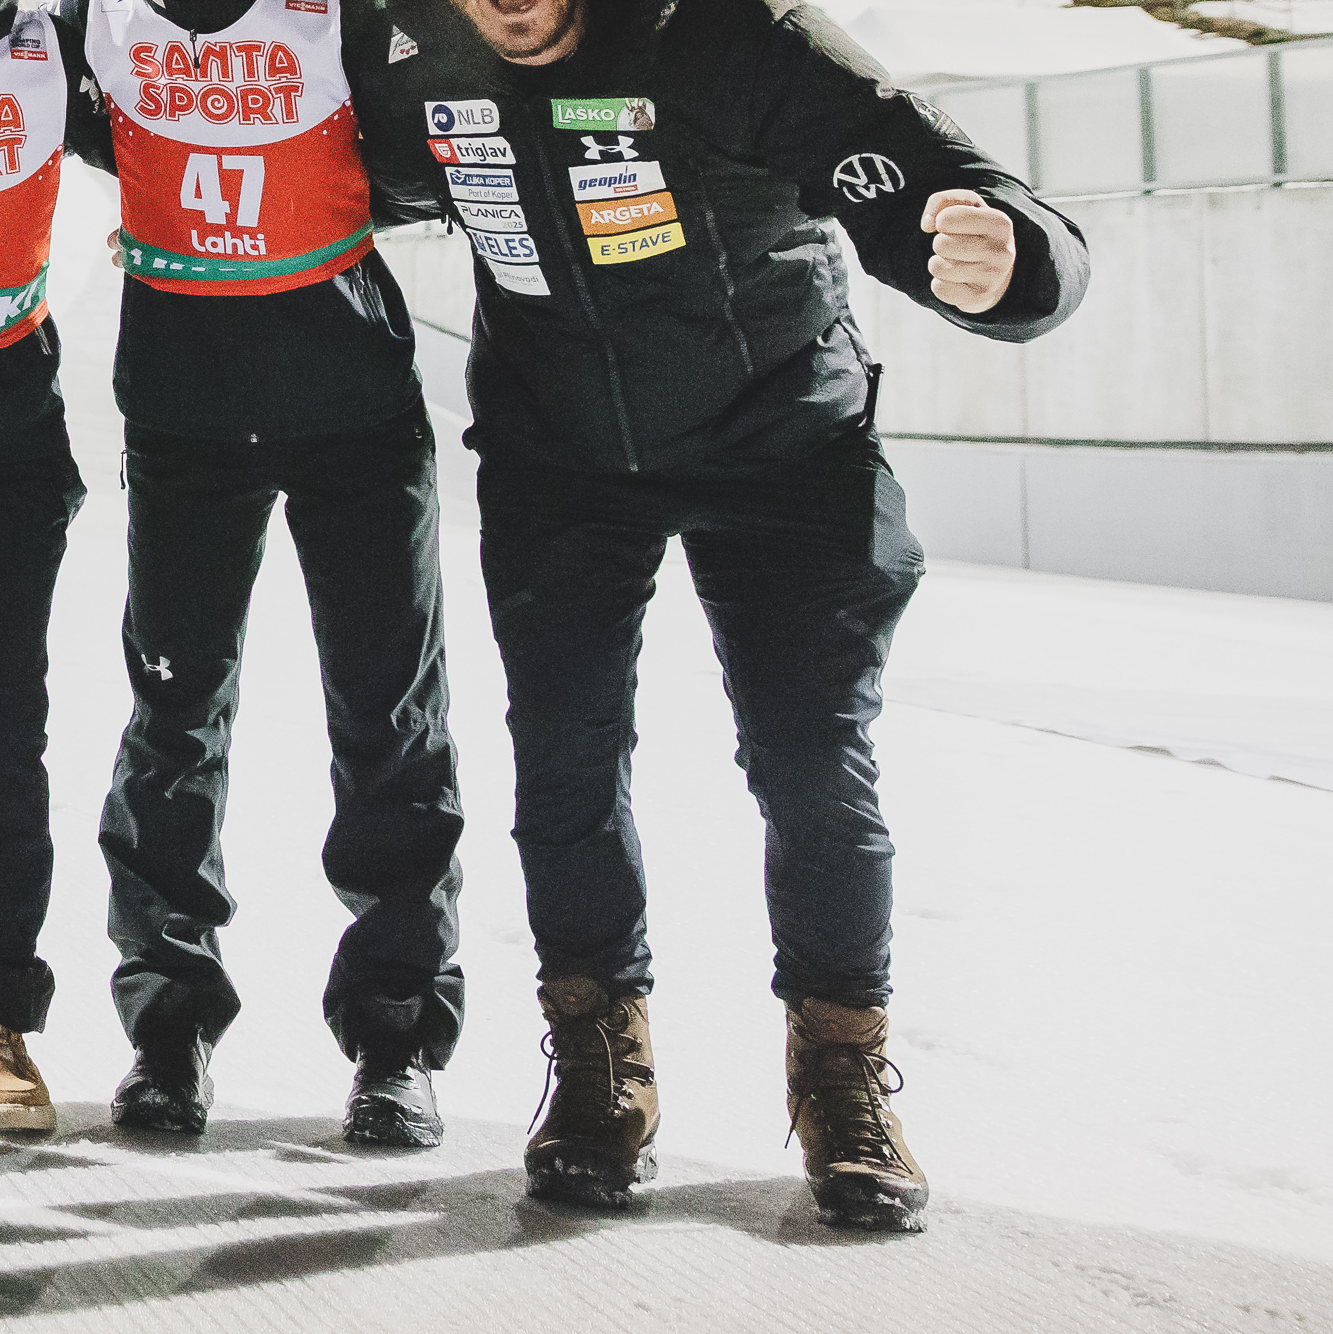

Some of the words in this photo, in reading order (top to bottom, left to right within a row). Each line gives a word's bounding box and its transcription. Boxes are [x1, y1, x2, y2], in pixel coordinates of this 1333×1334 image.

[129, 40, 302, 83] SANTA
[134, 79, 304, 125] SPORT
[456, 108, 494, 125] NLB
[557, 104, 615, 123] LAŠKO
[456, 143, 507, 162] triglav
[180, 152, 266, 228] 47
[466, 176, 484, 185] LUKA
[485, 177, 511, 186] KOPER
[578, 167, 637, 191] geoplin
[468, 188, 482, 197] Port
[483, 189, 491, 197] of
[491, 189, 513, 200] Koper
[461, 205, 521, 219] PLANICA
[591, 201, 664, 225] ARGETA
[191, 229, 267, 256] Lahti
[484, 236, 534, 258] ELES
